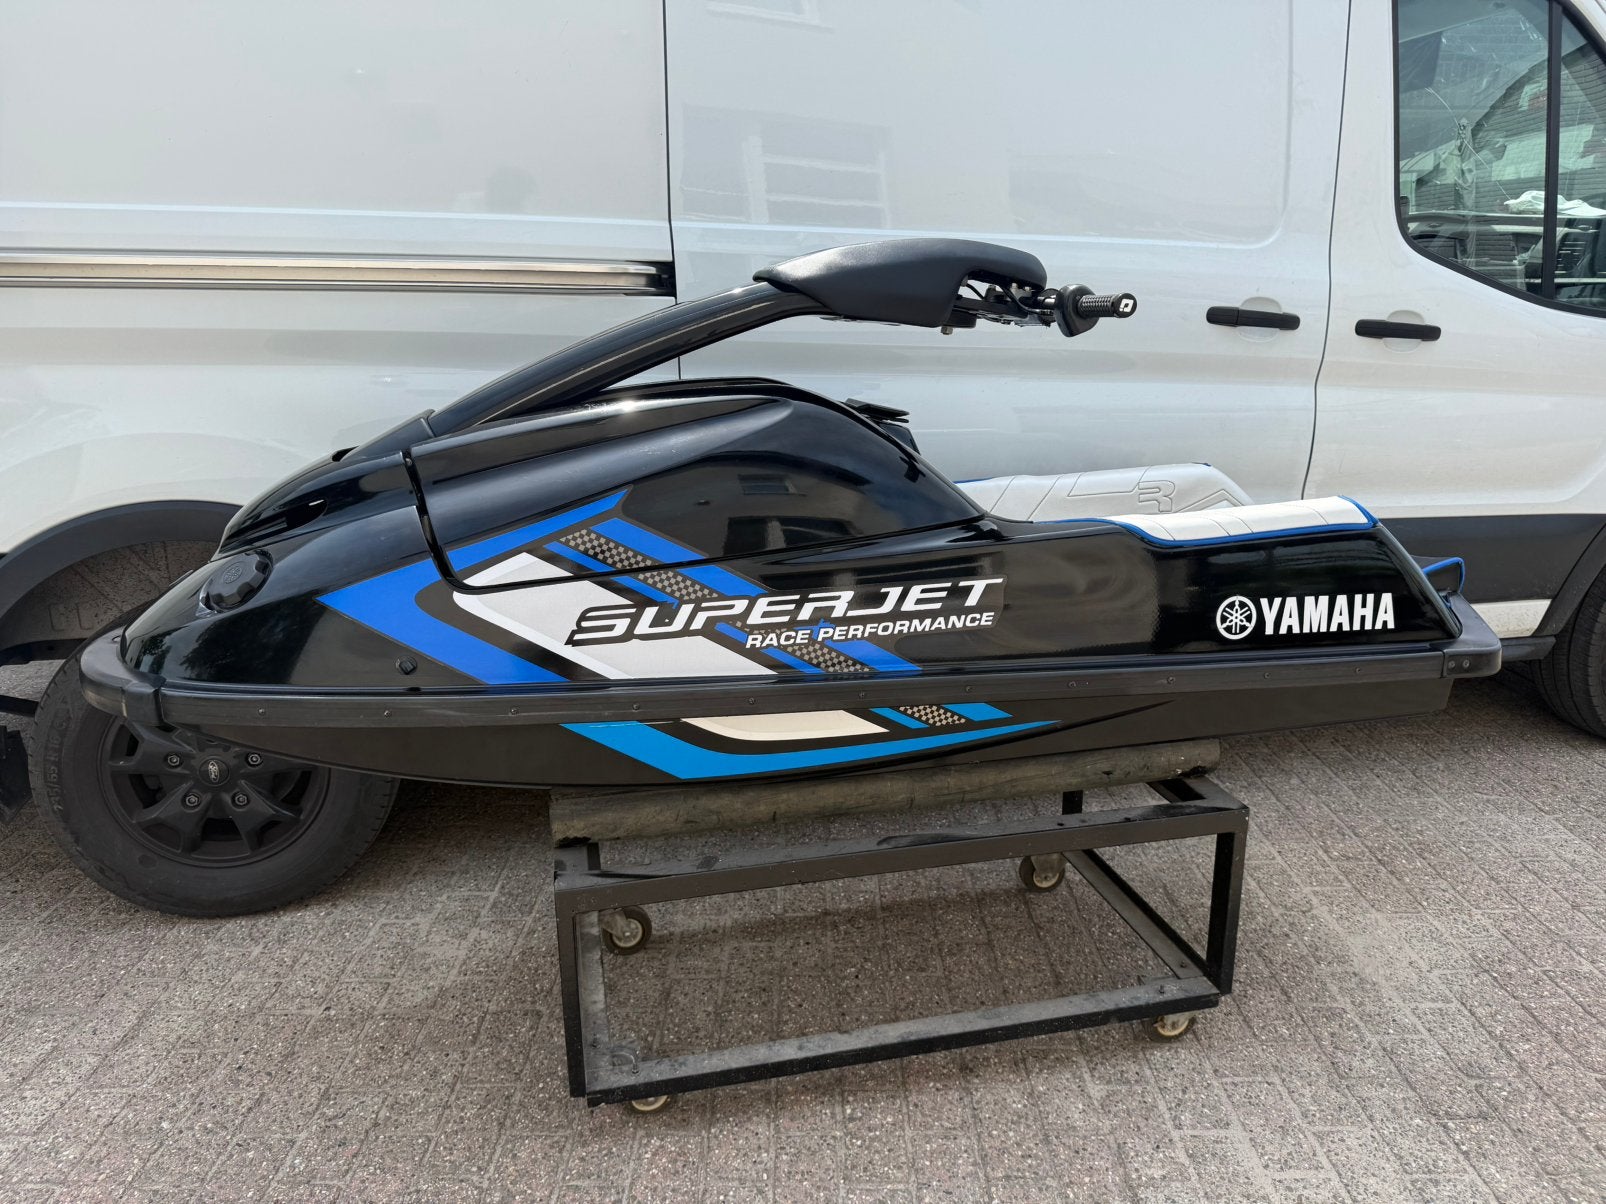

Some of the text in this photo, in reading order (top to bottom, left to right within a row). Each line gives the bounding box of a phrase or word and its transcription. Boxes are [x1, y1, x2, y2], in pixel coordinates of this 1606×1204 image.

[573, 577, 1004, 640] SUPERJET
[1259, 592, 1396, 635] YAMAHA
[745, 612, 995, 649] RACE PERFORMANCE
